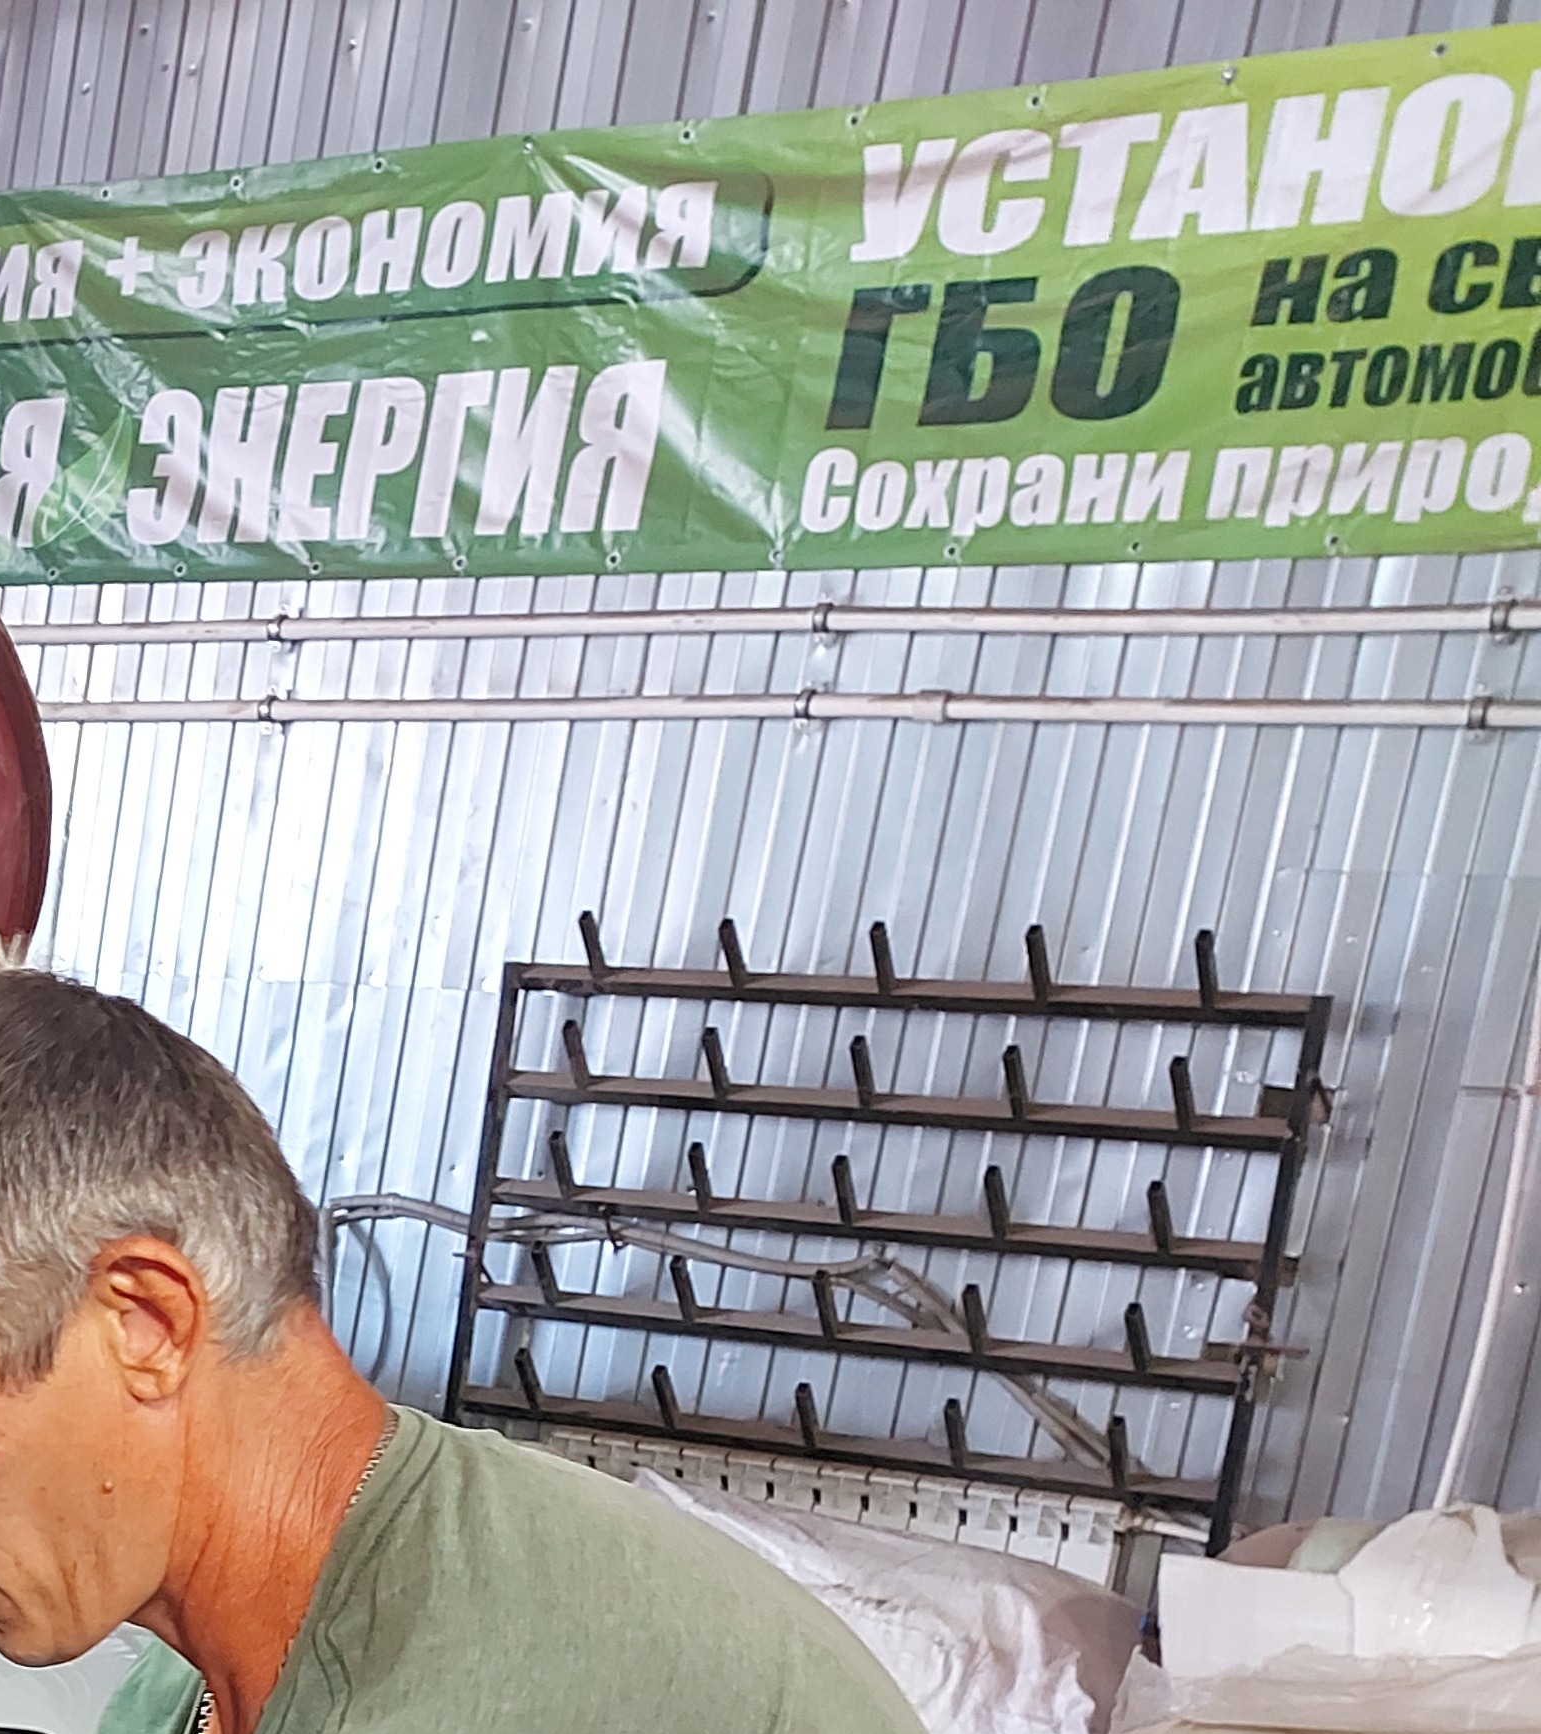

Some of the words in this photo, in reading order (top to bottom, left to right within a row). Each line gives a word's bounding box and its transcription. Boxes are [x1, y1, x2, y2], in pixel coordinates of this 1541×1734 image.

[175, 181, 718, 309] ЭКОНОМИЯ
[1250, 247, 1398, 326] на
[824, 265, 1182, 430] ГБО
[127, 360, 667, 545] ЭНЕРГИЯ
[799, 446, 1190, 537] Сохрани
[1204, 433, 1541, 527] приро
